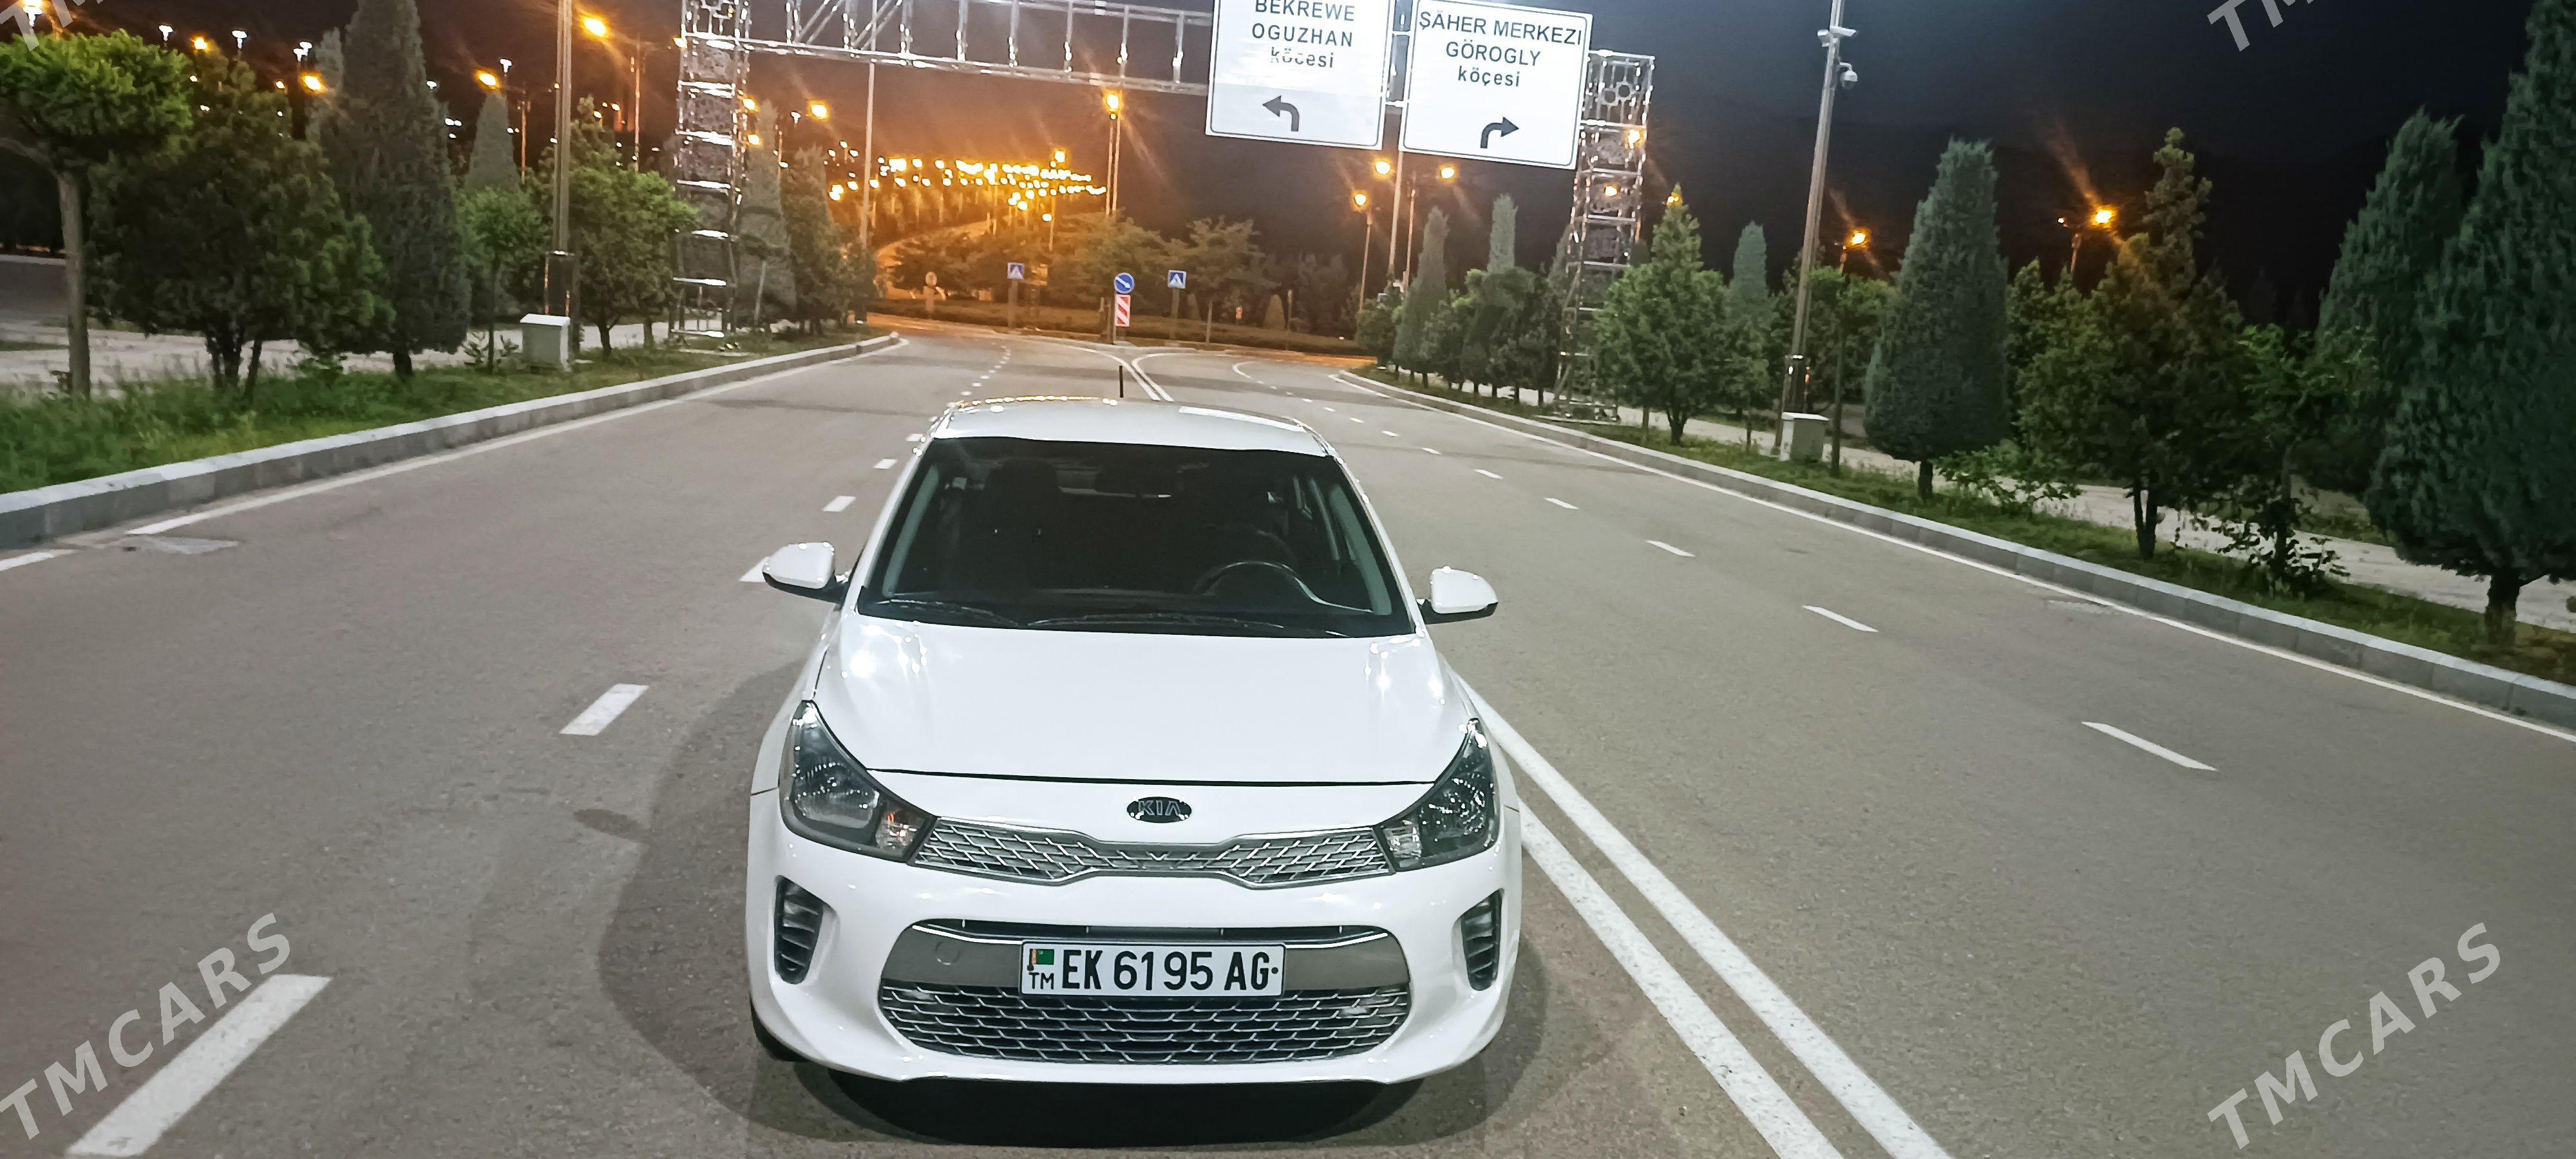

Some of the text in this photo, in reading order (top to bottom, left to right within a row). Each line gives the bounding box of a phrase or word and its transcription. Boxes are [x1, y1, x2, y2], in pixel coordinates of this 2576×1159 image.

[1255, 0, 1355, 21] BEKREWE
[1252, 23, 1352, 47] OGUZHAN
[1419, 10, 1582, 45] ŞÄHER MERKEZI
[1446, 39, 1540, 66] GÖROGLY
[1458, 66, 1520, 86] köçesi
[1138, 800, 1181, 816] KIA
[1061, 949, 1270, 990] EK 6195 AG
[1028, 972, 1054, 990] TM
